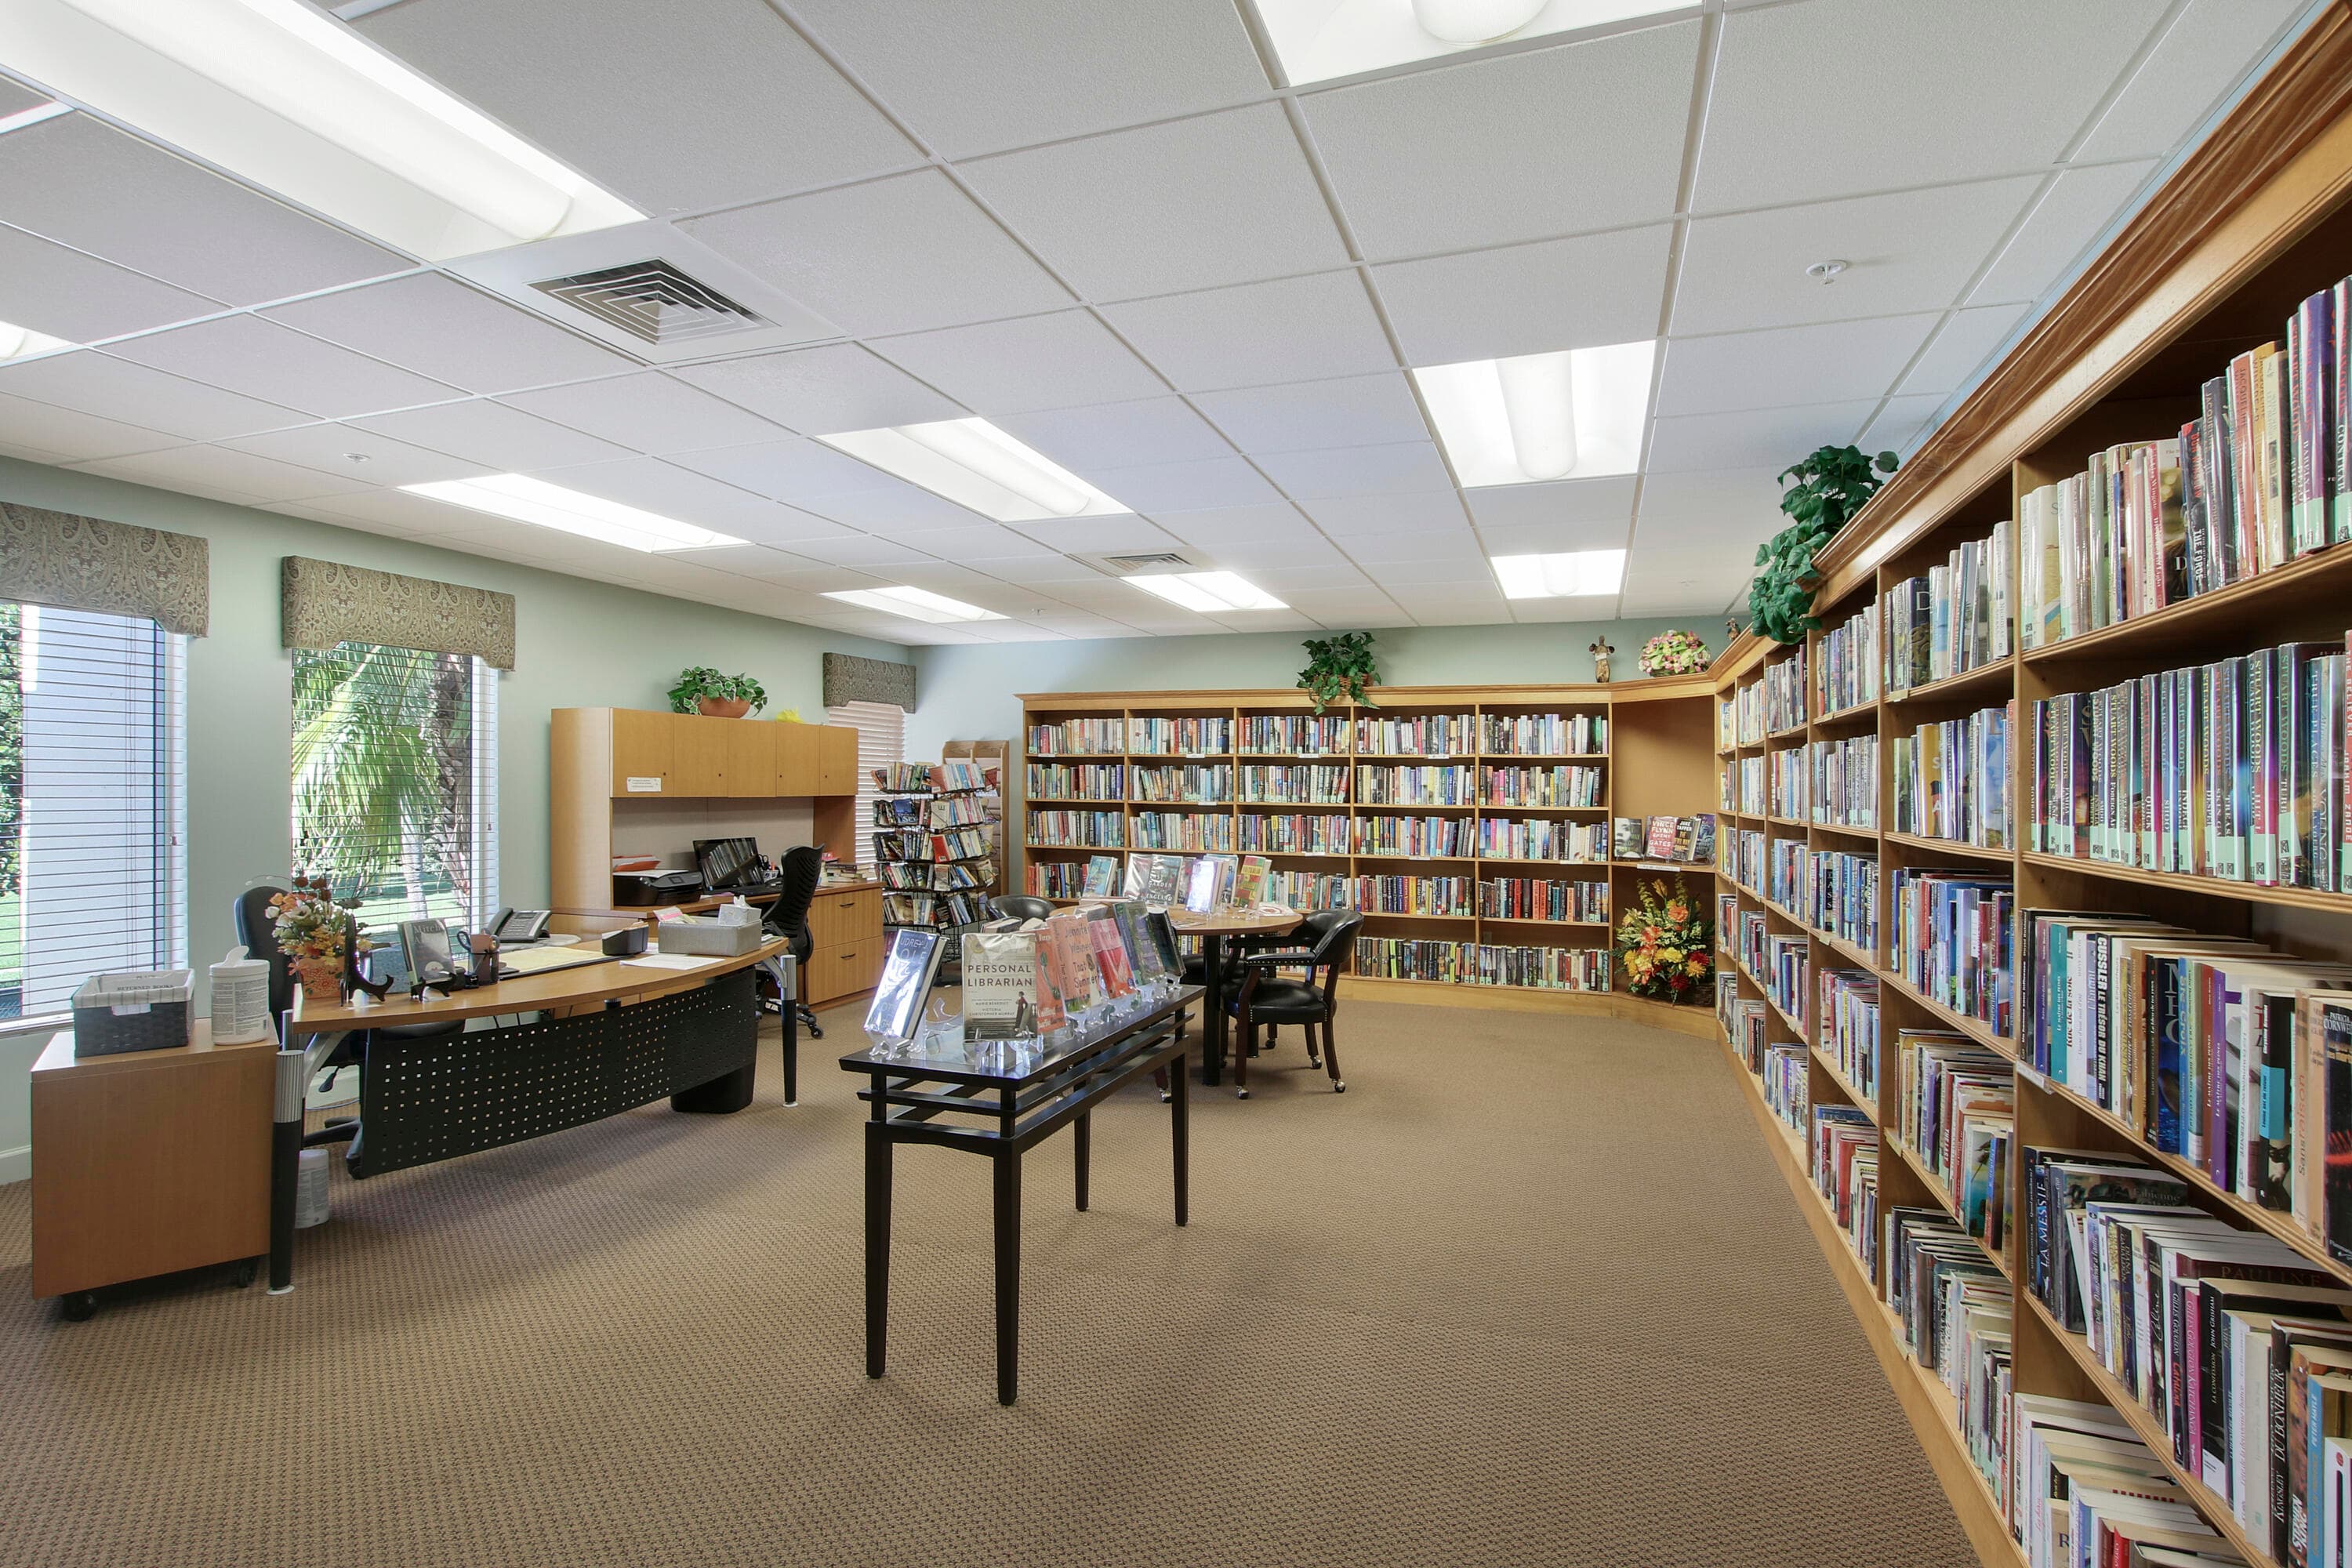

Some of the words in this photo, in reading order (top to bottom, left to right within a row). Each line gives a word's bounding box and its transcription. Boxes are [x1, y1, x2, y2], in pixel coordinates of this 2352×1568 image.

[2193, 528, 2202, 547] THE
[2194, 550, 2204, 581] FORCE
[967, 964, 1032, 973] PERSONAL
[1073, 961, 1087, 973] That
[2097, 936, 2107, 990] CUSSLER
[967, 978, 1033, 986] LIBRARIAN
[2066, 1000, 2072, 1010] la
[2098, 990, 2106, 1002] LE
[2066, 1011, 2072, 1025] de
[2098, 1003, 2107, 1039] TRÉSOR
[2329, 1011, 2350, 1022] PATRICIA
[2098, 1040, 2107, 1054] DU
[2098, 1054, 2107, 1082] KHAN
[2297, 1074, 2306, 1139] raison
[2132, 1188, 2181, 1202] Fabienne
[2220, 1265, 2322, 1286] PAULINE
[2187, 1300, 2195, 1328] GILLES
[2211, 1395, 2217, 1404] LA
[2274, 1367, 2285, 1437] BONHEUR
[2274, 1437, 2285, 1462] DU
[2274, 1469, 2285, 1523] KINGSLEY
[2292, 1494, 2303, 1553] STEPHEN
